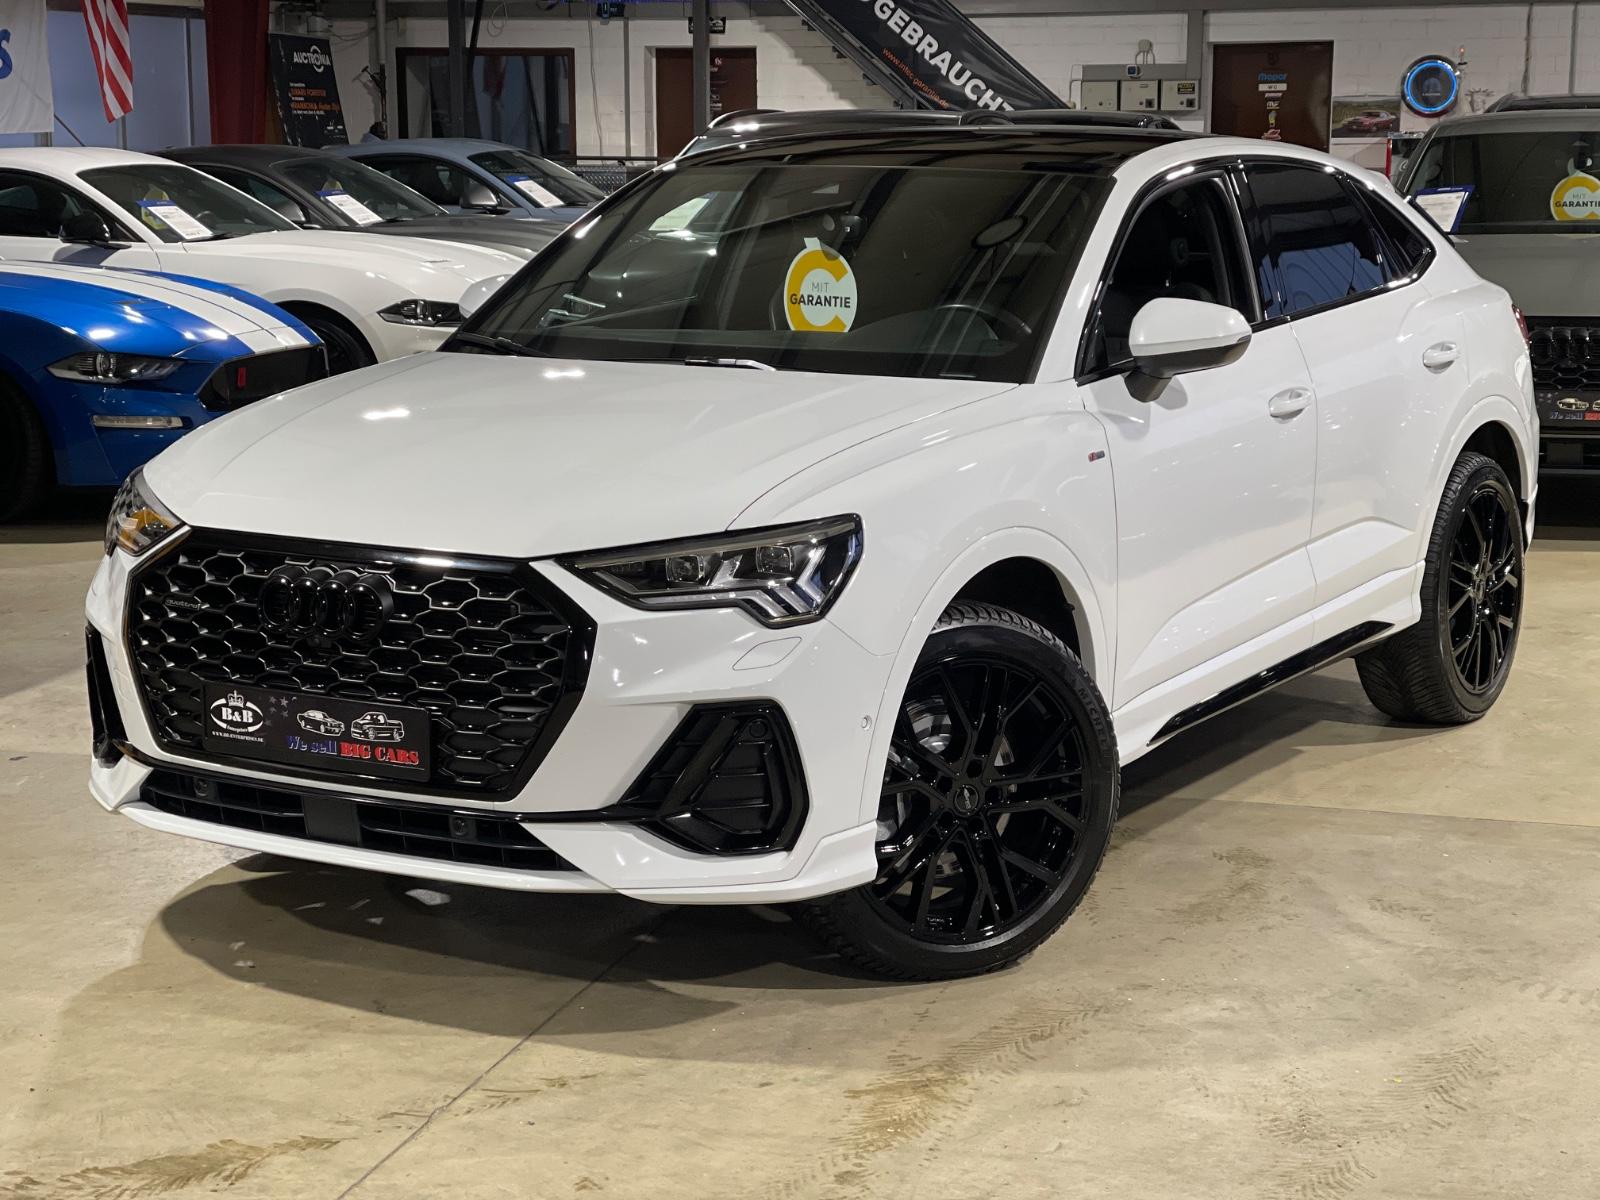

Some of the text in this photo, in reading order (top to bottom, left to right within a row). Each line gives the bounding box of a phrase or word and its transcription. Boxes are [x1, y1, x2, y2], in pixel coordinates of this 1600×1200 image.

[811, 282, 831, 293] MIT
[790, 294, 851, 308] GARANTIE
[221, 707, 253, 723] B&B
[287, 735, 420, 766] We sell BIG CARS
